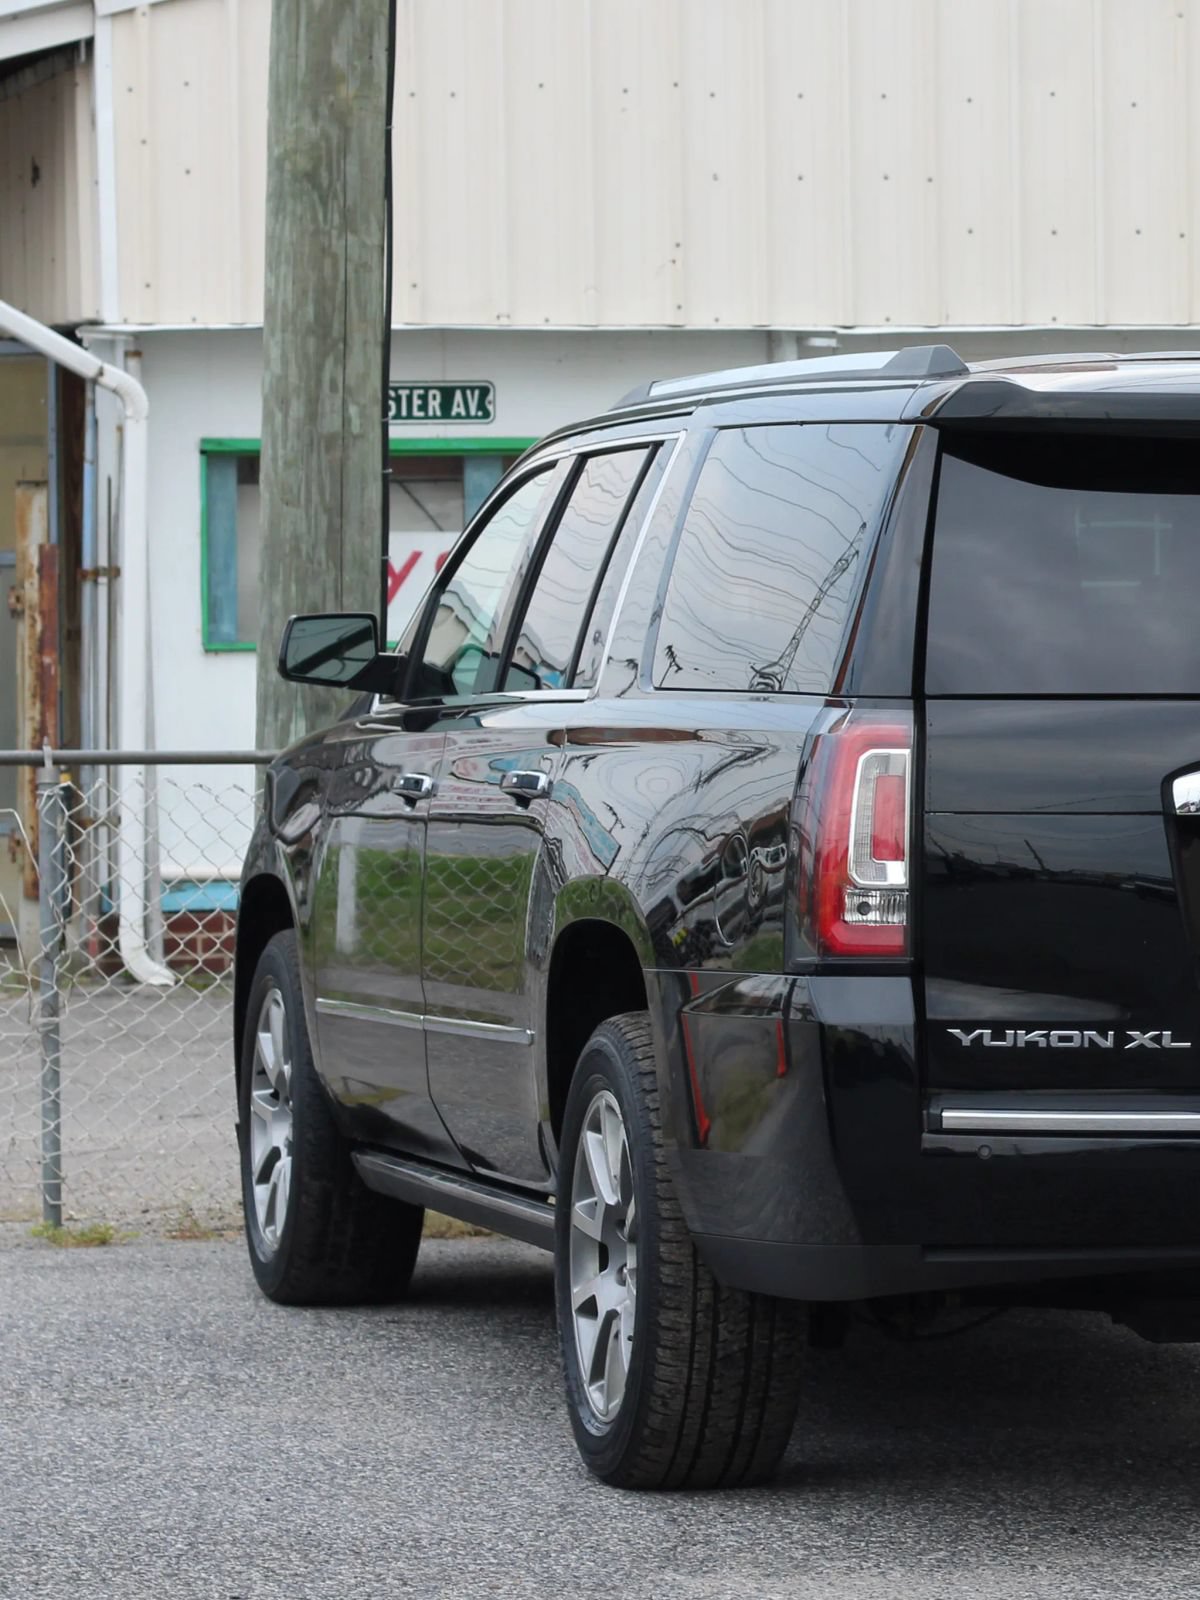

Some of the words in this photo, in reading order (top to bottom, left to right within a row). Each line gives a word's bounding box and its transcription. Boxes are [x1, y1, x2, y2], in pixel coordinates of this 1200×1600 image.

[450, 389, 483, 417] AV.
[946, 1028, 1114, 1048] YUKON
[1124, 1031, 1192, 1049] XL
